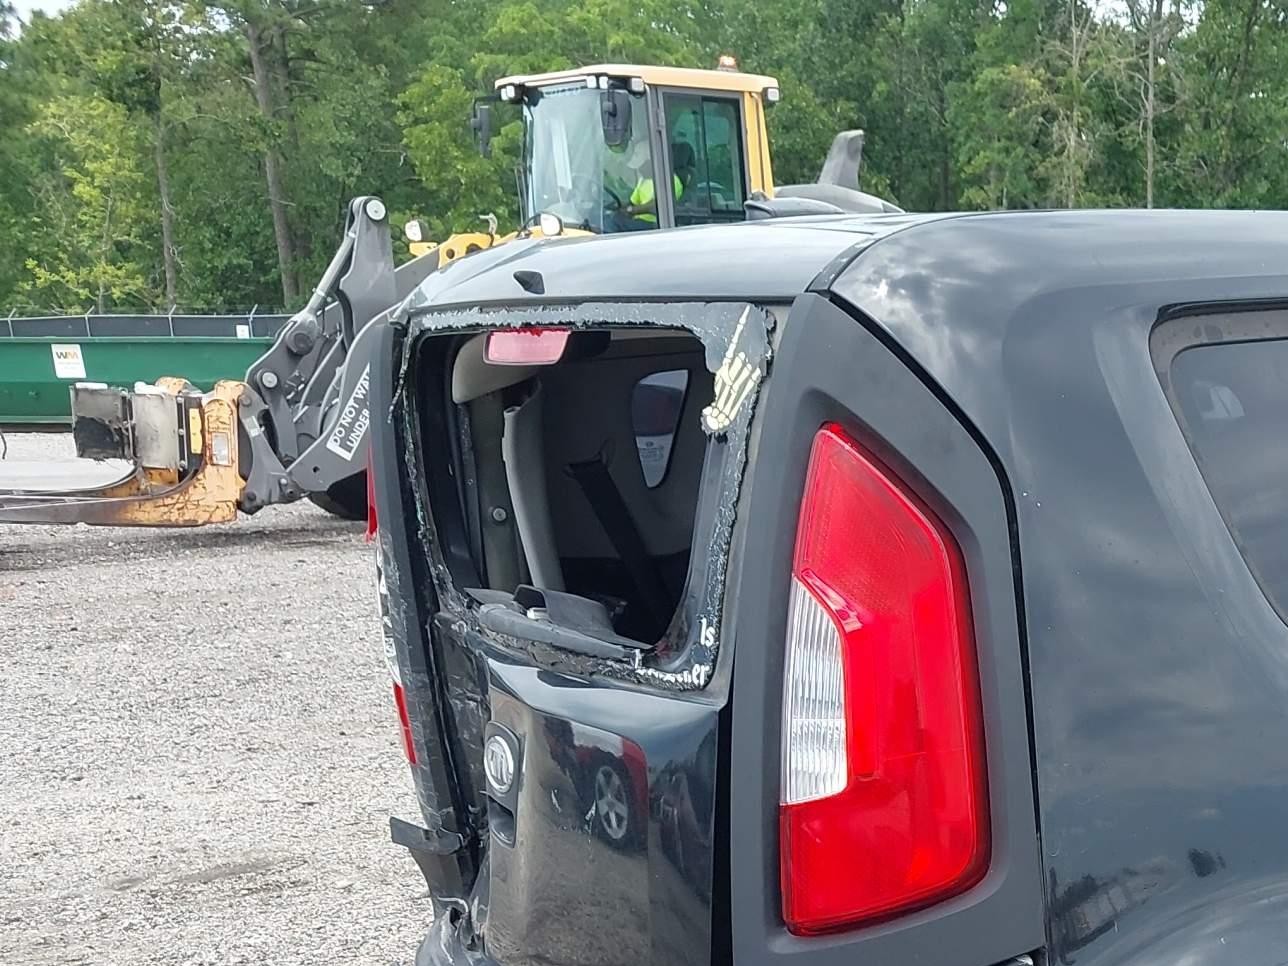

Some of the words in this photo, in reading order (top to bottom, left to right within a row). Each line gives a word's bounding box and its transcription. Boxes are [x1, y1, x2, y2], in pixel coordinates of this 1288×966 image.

[55, 351, 79, 359] WM
[333, 427, 346, 446] DO
[341, 399, 359, 426] NOT
